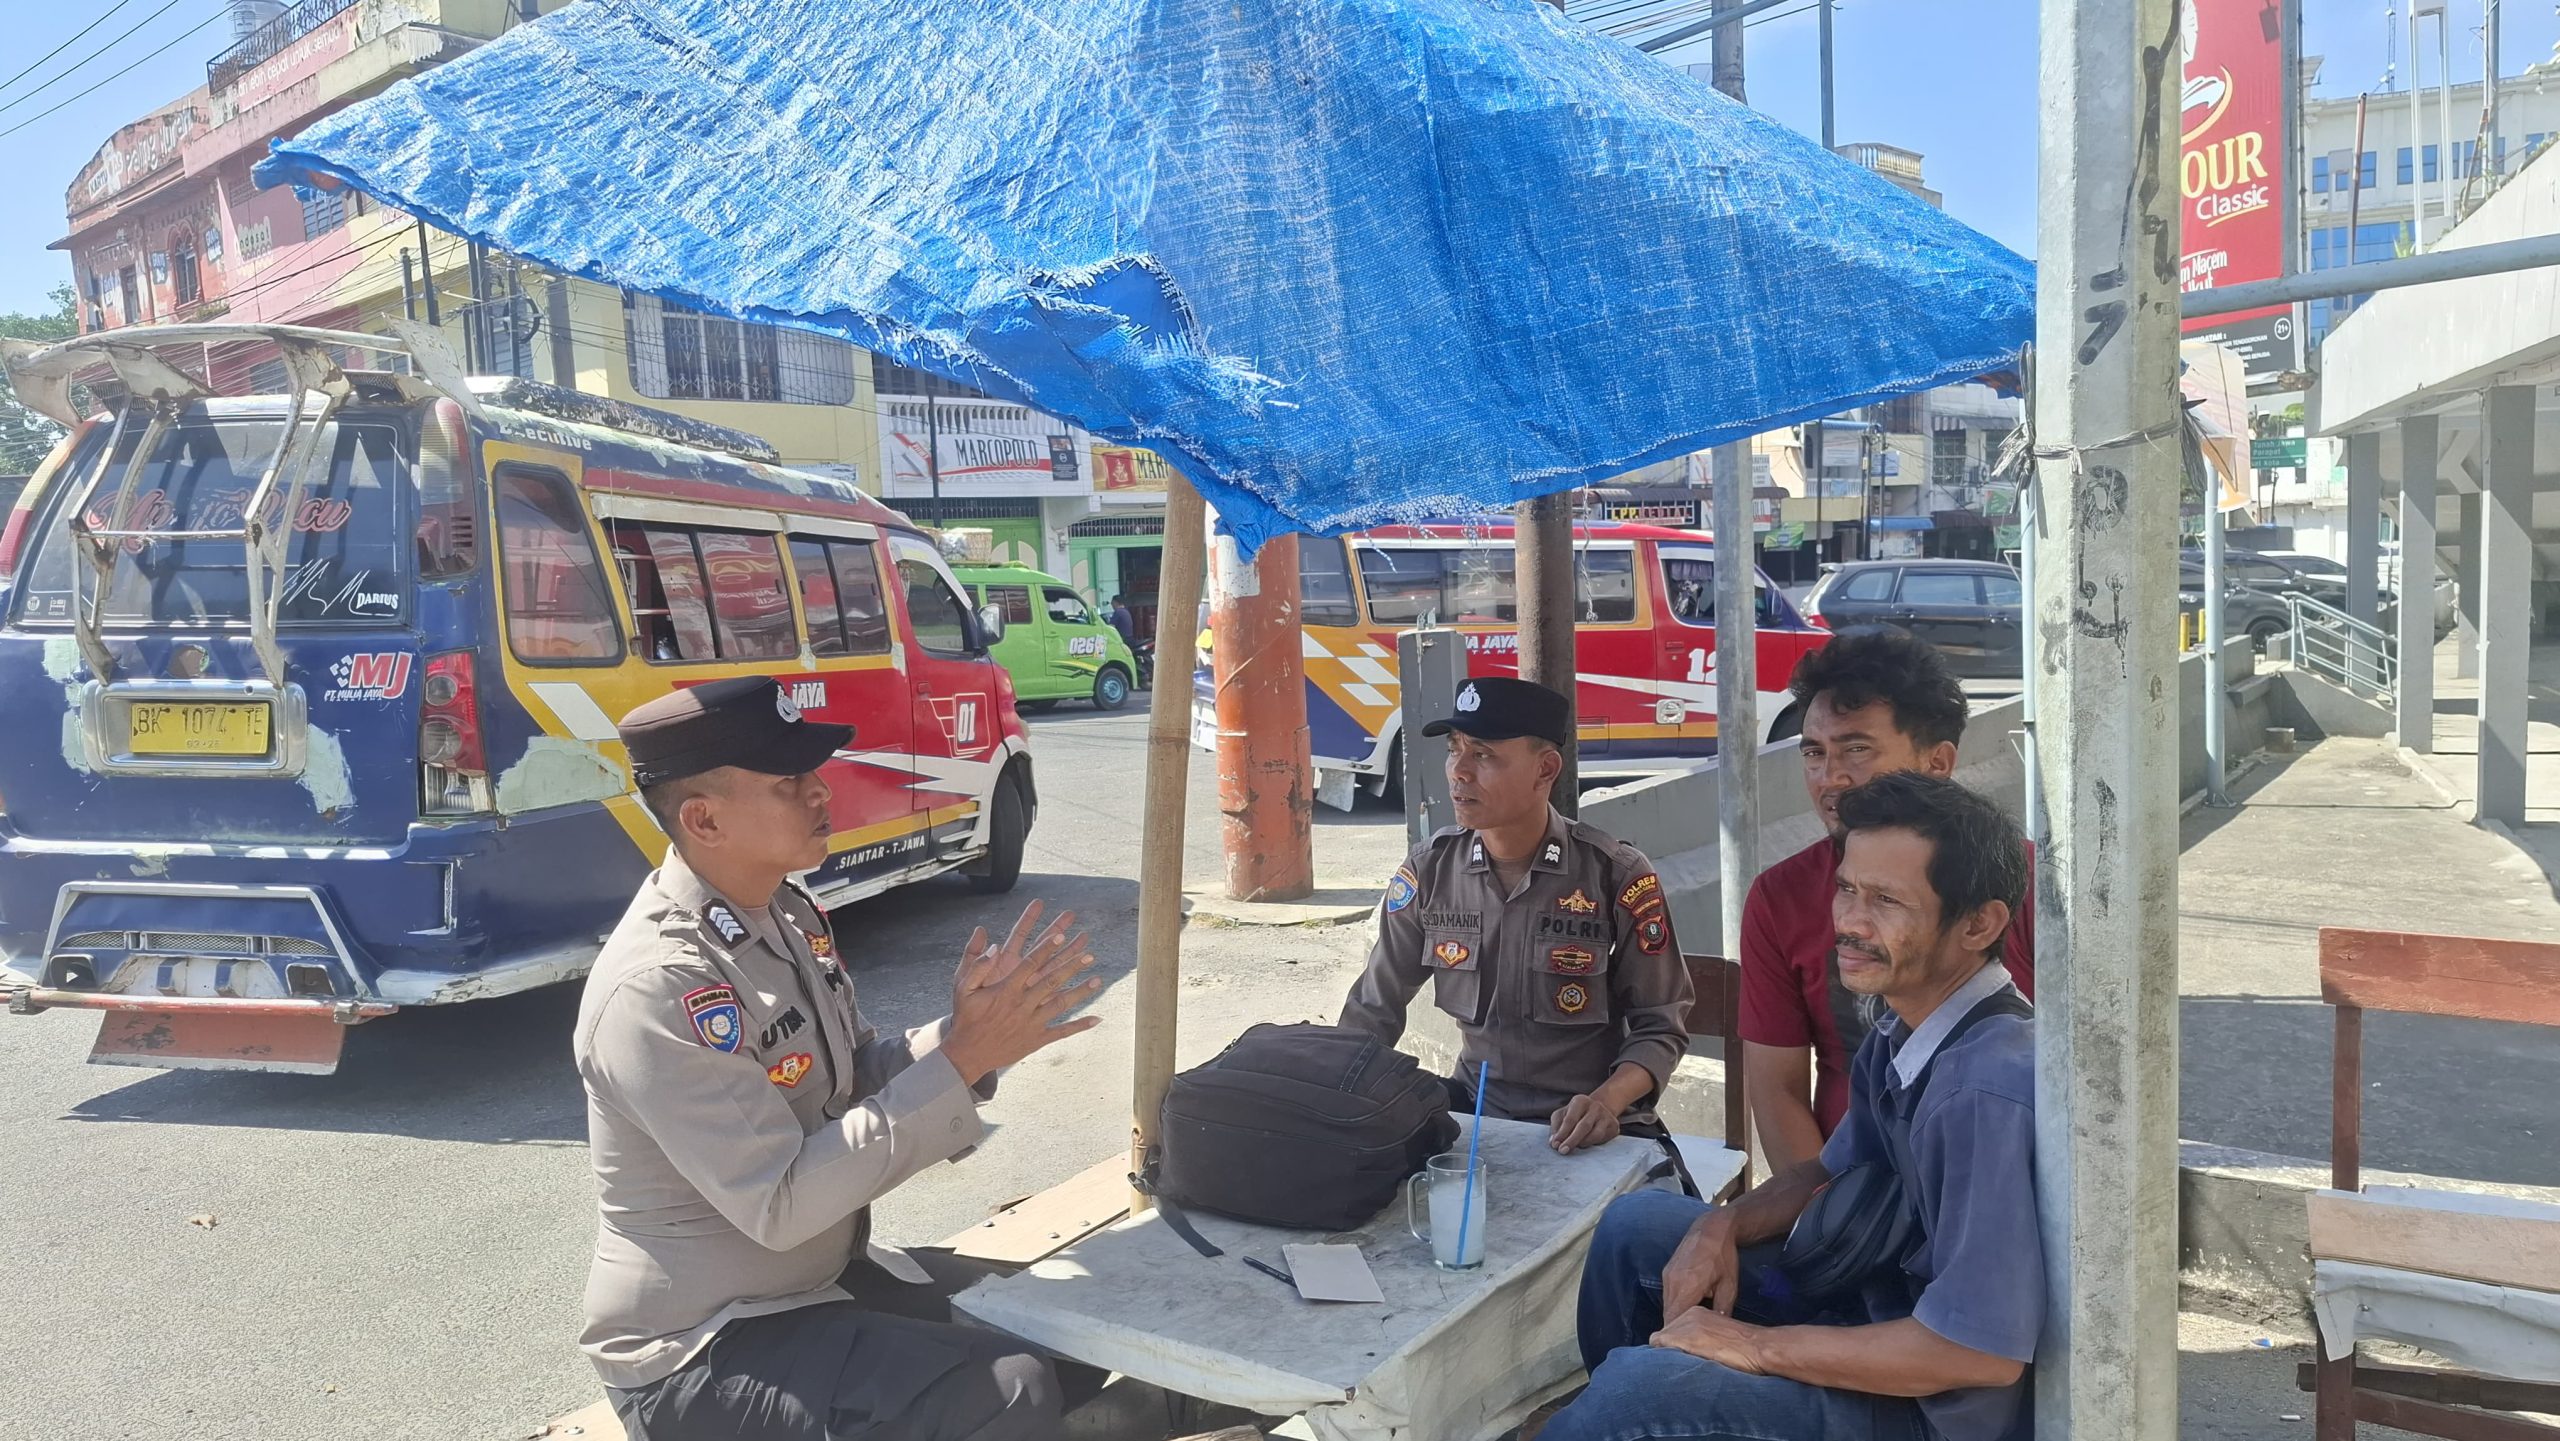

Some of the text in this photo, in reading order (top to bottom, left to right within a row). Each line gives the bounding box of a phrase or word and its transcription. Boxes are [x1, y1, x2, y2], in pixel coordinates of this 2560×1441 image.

[267, 58, 290, 80] cepat
[290, 46, 313, 66] untuk
[2196, 184, 2268, 220] Classic
[954, 438, 1039, 467] MARCOPOLO
[356, 592, 399, 610] DARIUS
[1069, 637, 1096, 655] 026
[348, 652, 413, 699] MJ
[338, 689, 362, 700] MULIA
[362, 688, 383, 700] JAYA
[138, 706, 264, 735] BK 1074 TE
[957, 702, 977, 743] 01
[892, 834, 926, 855] T.JAWA
[1621, 875, 1656, 904] POLRES
[1423, 912, 1480, 929] S.DAMANIK
[1540, 916, 1601, 938] POLRI
